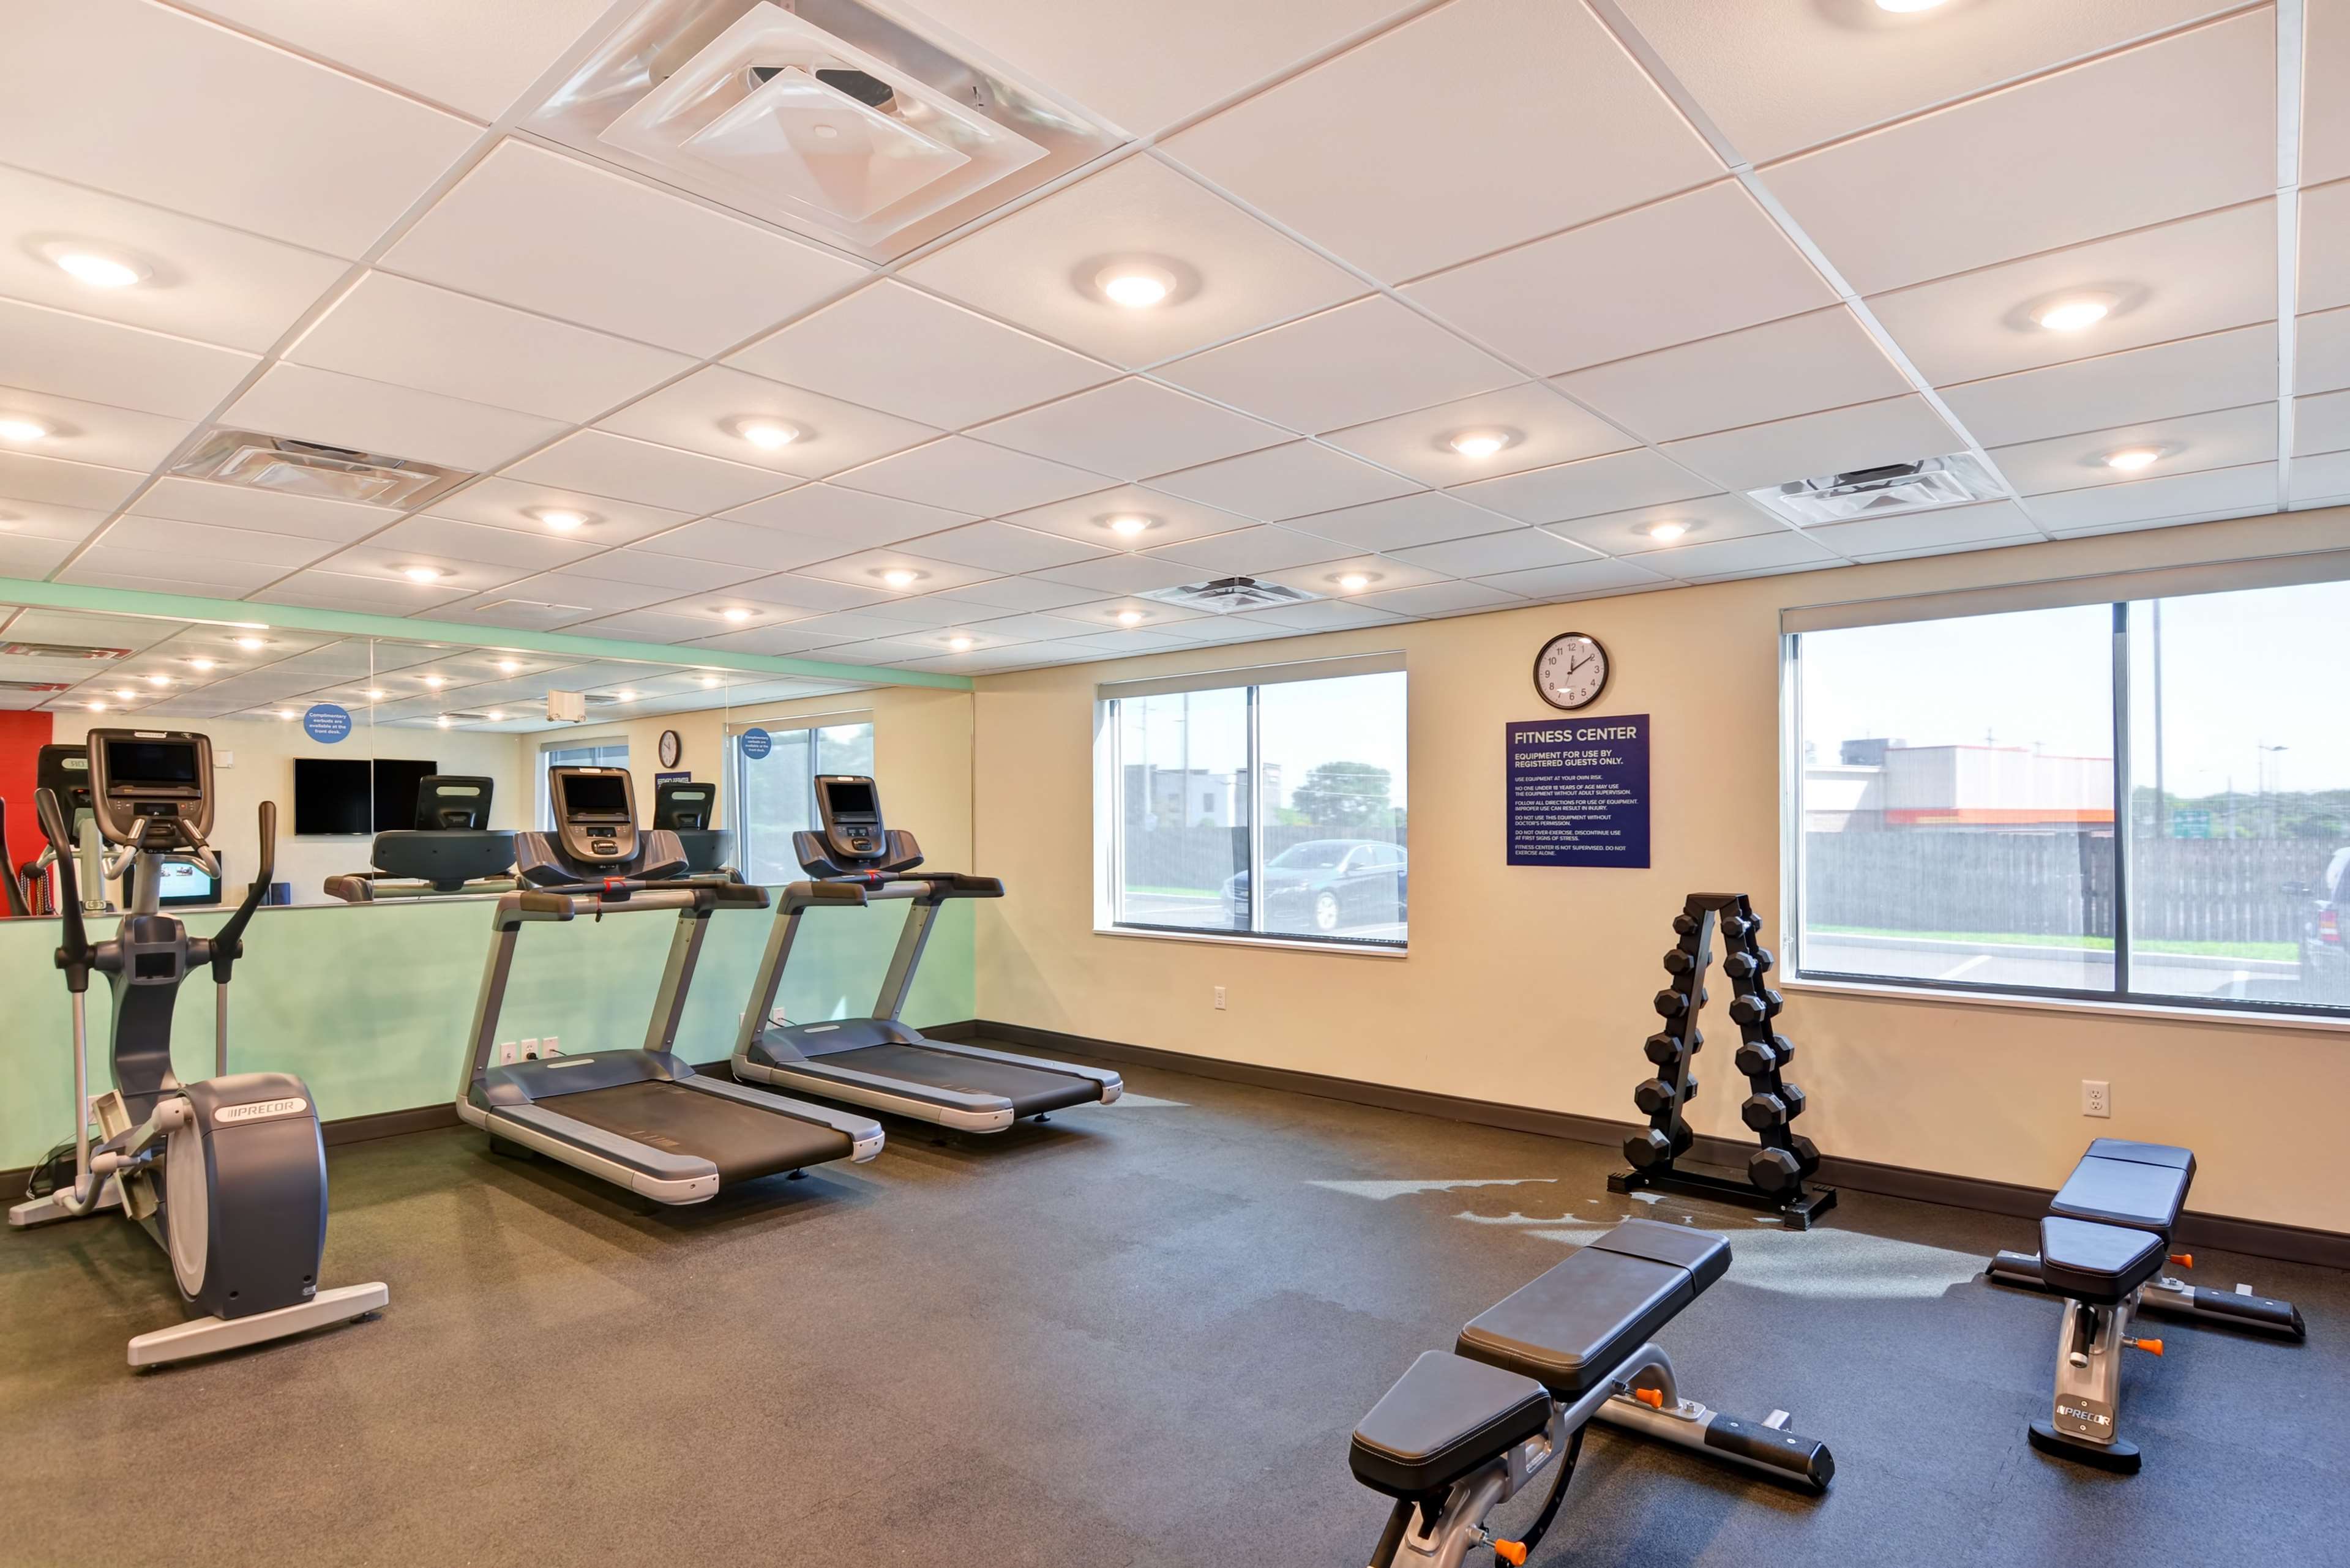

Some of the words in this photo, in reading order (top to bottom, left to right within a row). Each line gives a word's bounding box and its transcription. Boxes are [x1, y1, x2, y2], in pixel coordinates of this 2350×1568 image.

[1548, 657, 1557, 665] 10
[1514, 730, 1573, 744] FITNESS
[1576, 726, 1637, 741] CENTER
[1515, 752, 1561, 760] EQUIPMENT
[238, 1102, 294, 1116] PRECOR
[2065, 1406, 2111, 1426] PRECOR
